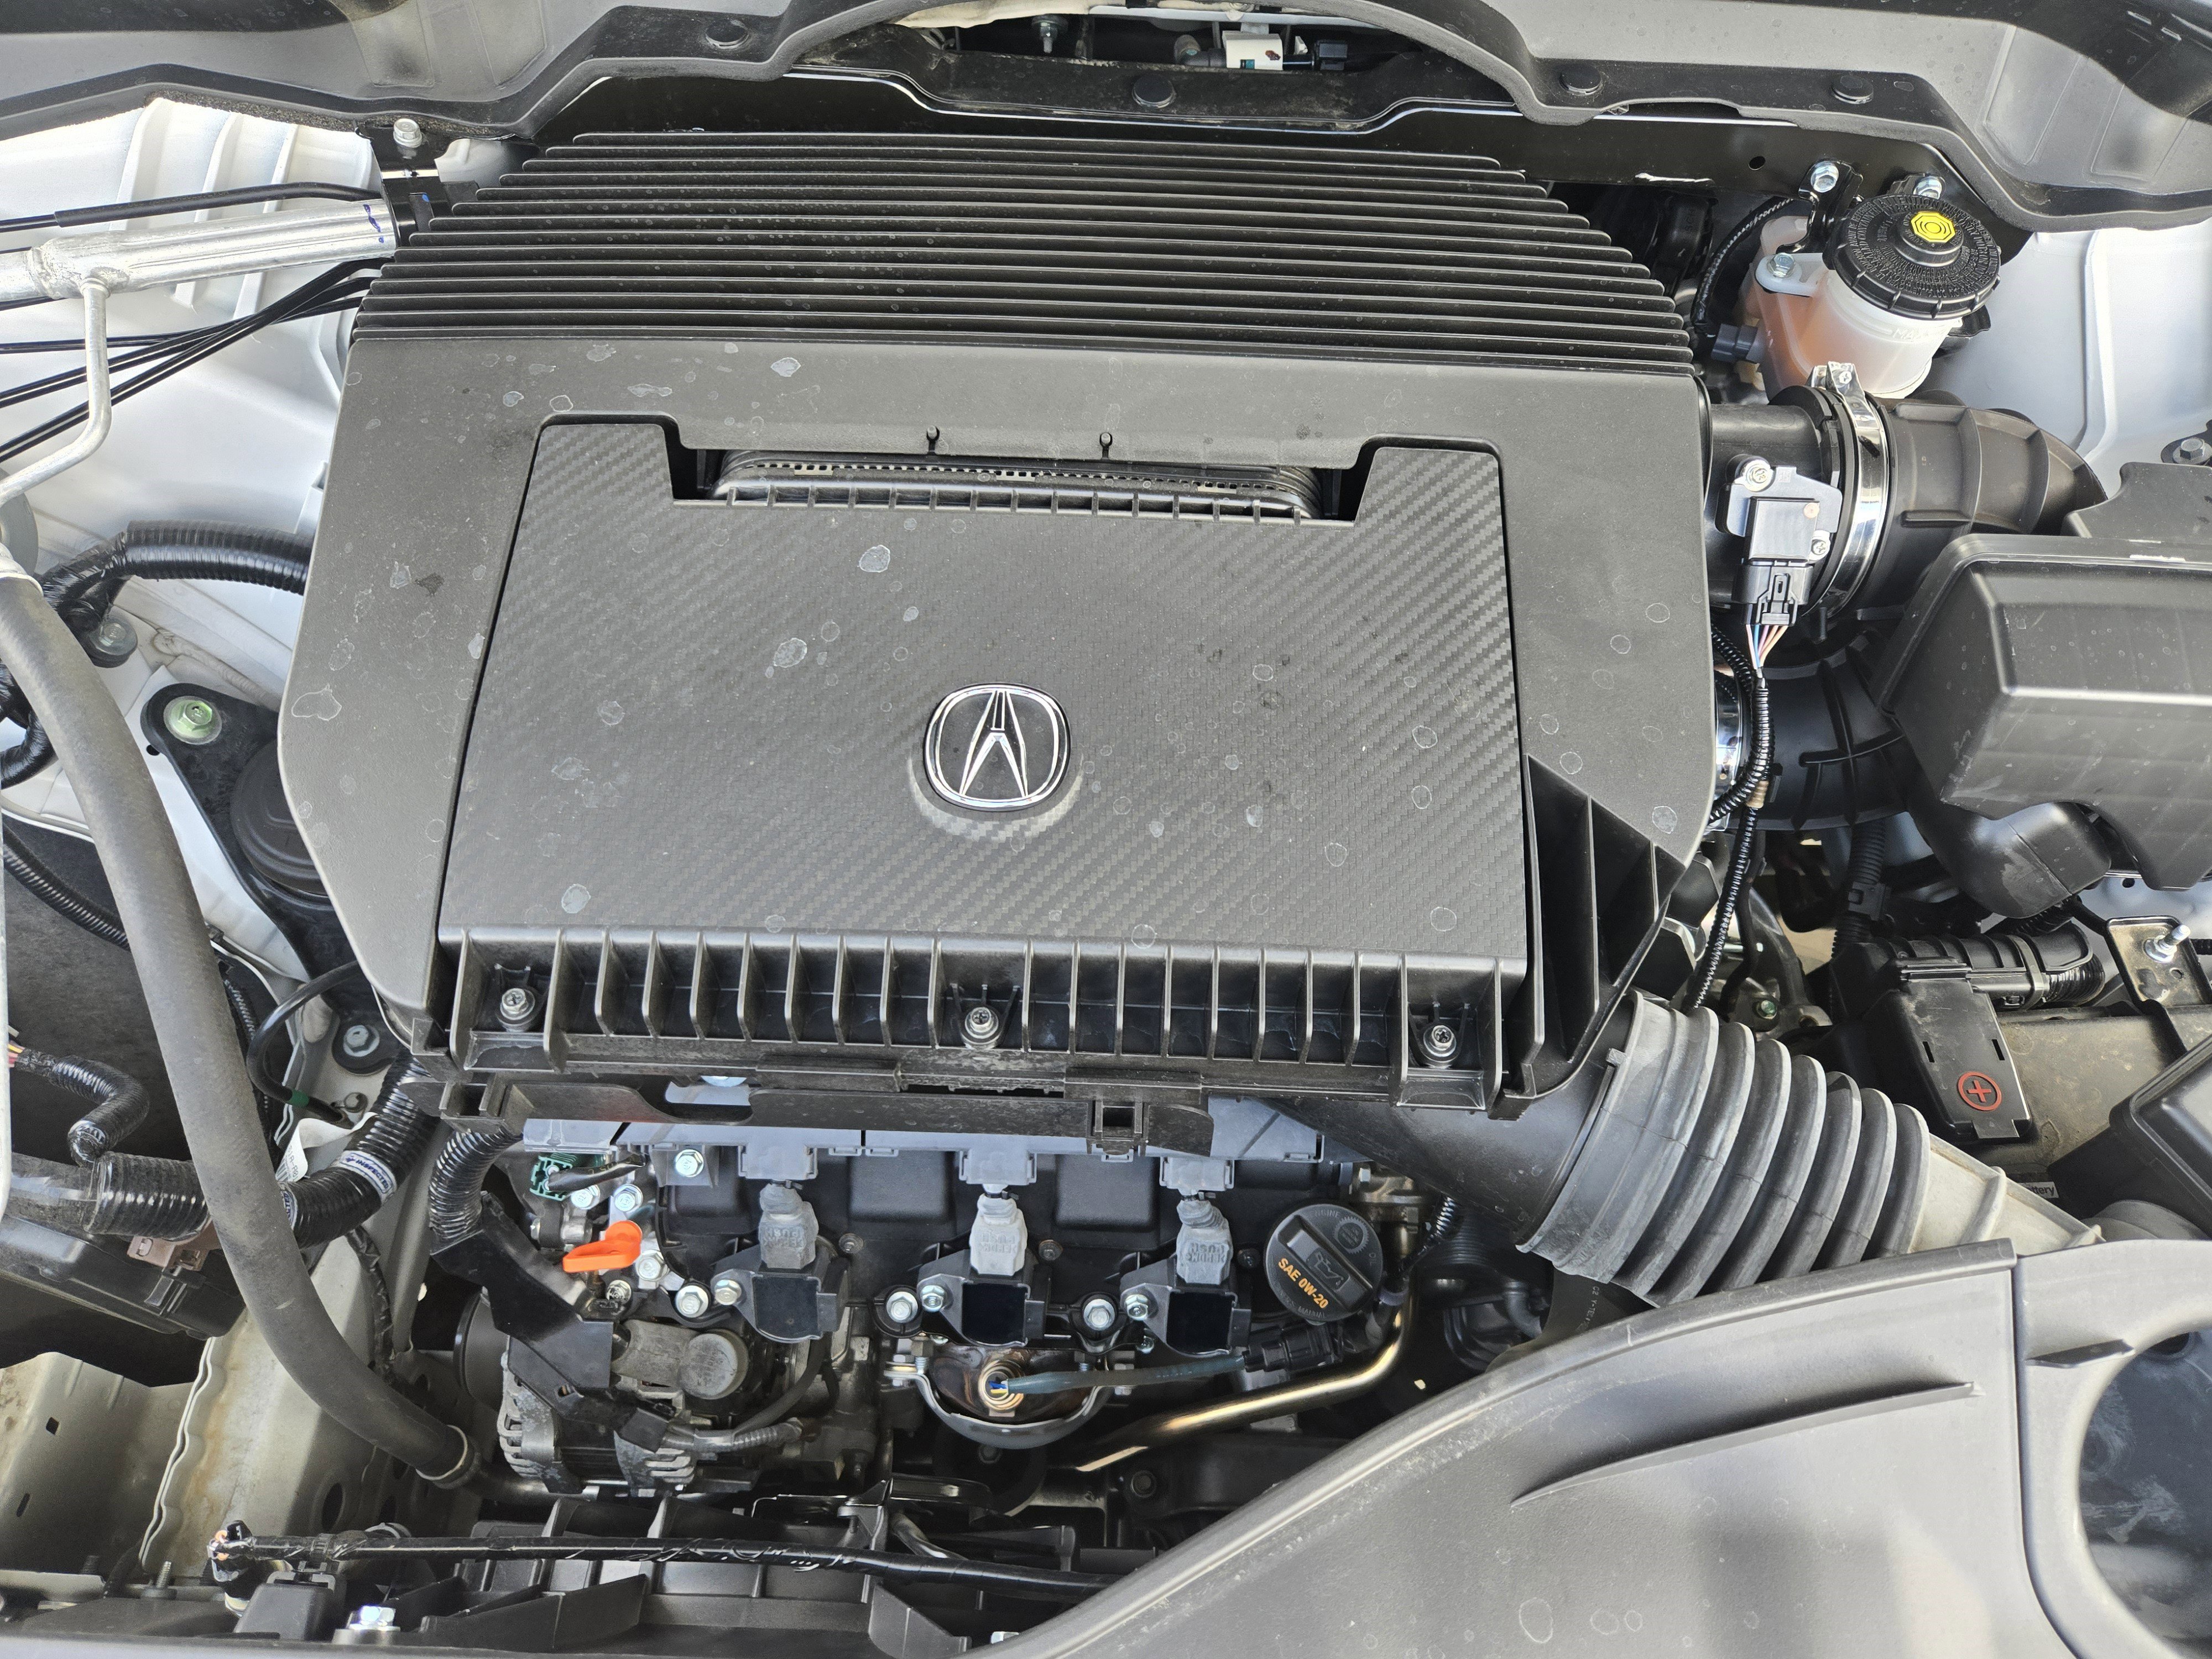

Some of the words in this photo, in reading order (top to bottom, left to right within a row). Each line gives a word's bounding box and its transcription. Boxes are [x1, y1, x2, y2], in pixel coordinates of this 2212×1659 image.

[1877, 195, 1939, 207] ATTENTION
[354, 1159, 389, 1189] INSPECTED
[1310, 1209, 1340, 1218] ENGINE
[1277, 1258, 1301, 1282] SAE
[1298, 1277, 1329, 1309] 0W-20
